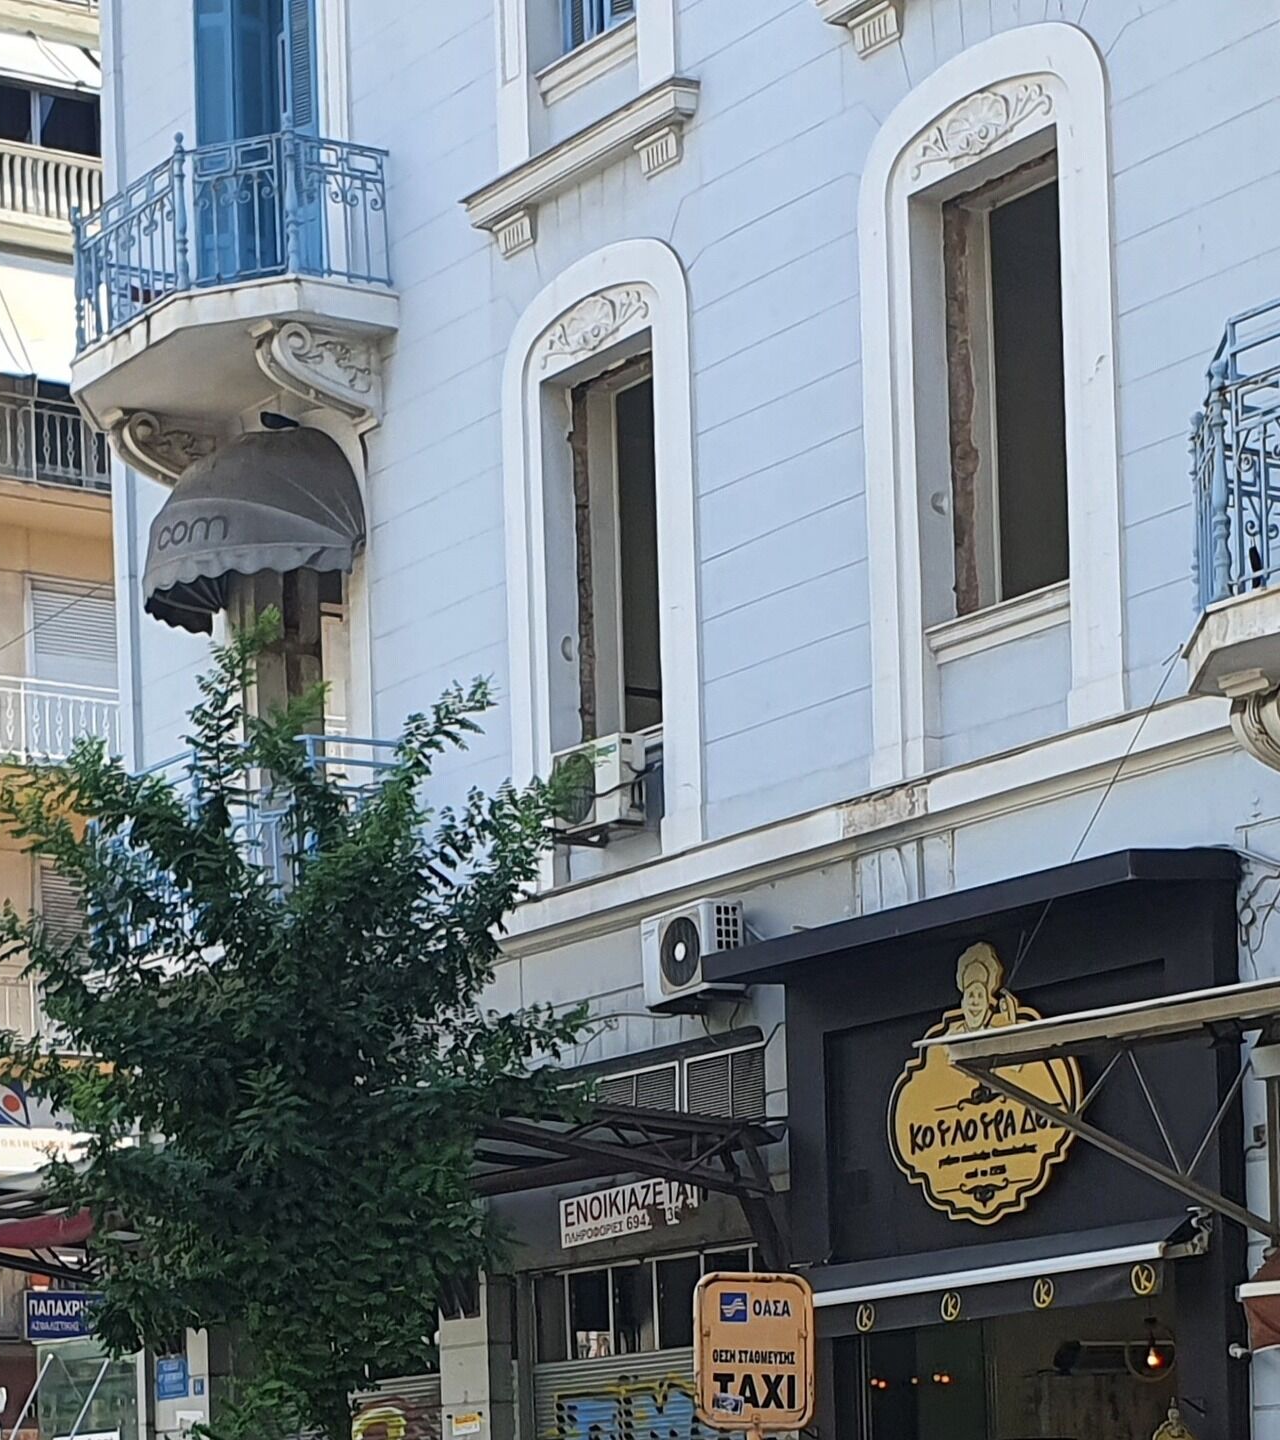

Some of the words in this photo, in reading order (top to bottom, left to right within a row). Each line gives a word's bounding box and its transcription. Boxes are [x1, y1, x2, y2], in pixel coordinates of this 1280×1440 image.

[158, 515, 228, 551] com
[753, 1300, 791, 1318] ΟΑΣΑ
[738, 1350, 796, 1366] ΣΤΑΘΜΕΥΣΗΣ
[713, 1372, 797, 1410] TAXI
